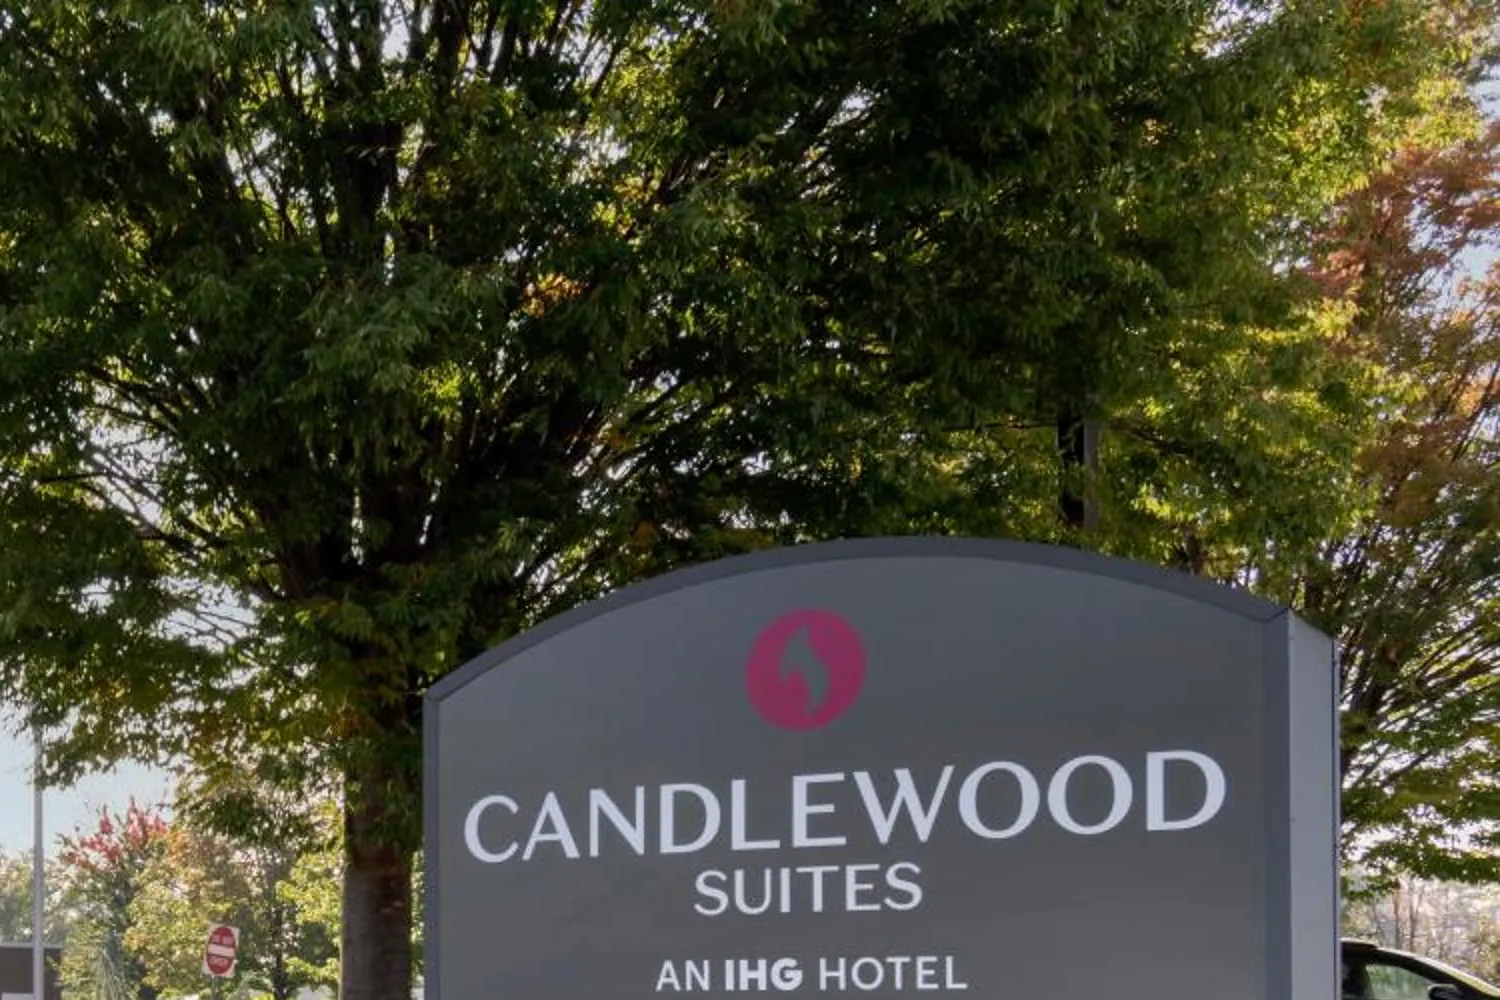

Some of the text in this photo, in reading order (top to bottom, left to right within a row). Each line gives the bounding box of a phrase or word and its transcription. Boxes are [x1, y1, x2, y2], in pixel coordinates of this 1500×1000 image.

[465, 750, 1225, 864] CANDLEWOOD
[694, 861, 923, 916] SUITES
[656, 955, 968, 991] AN IHG HOTEL
